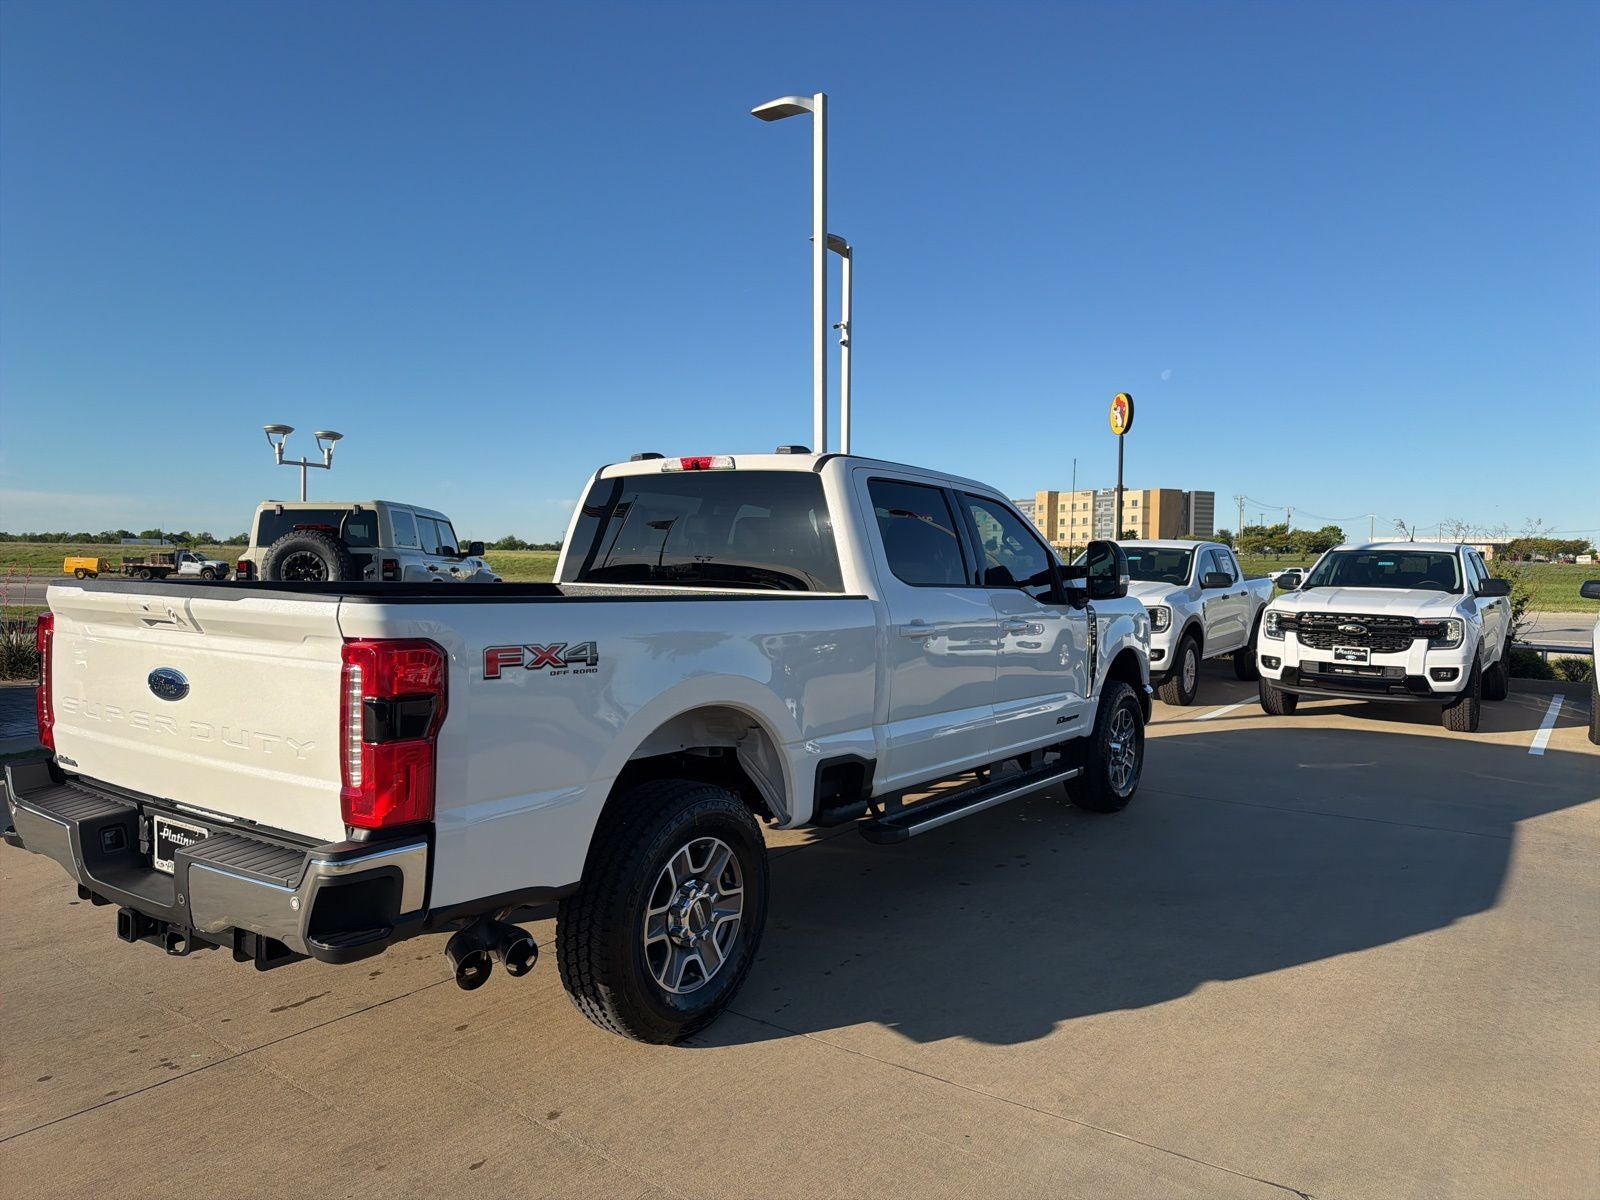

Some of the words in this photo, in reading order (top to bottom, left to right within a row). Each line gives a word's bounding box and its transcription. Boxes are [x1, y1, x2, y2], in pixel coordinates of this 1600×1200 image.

[483, 641, 599, 680] FX4
[549, 669, 570, 677] OFF
[572, 667, 598, 675] ROAD
[62, 695, 178, 736] SUPER
[190, 719, 316, 761] DUTY
[160, 827, 197, 847] Platinu
